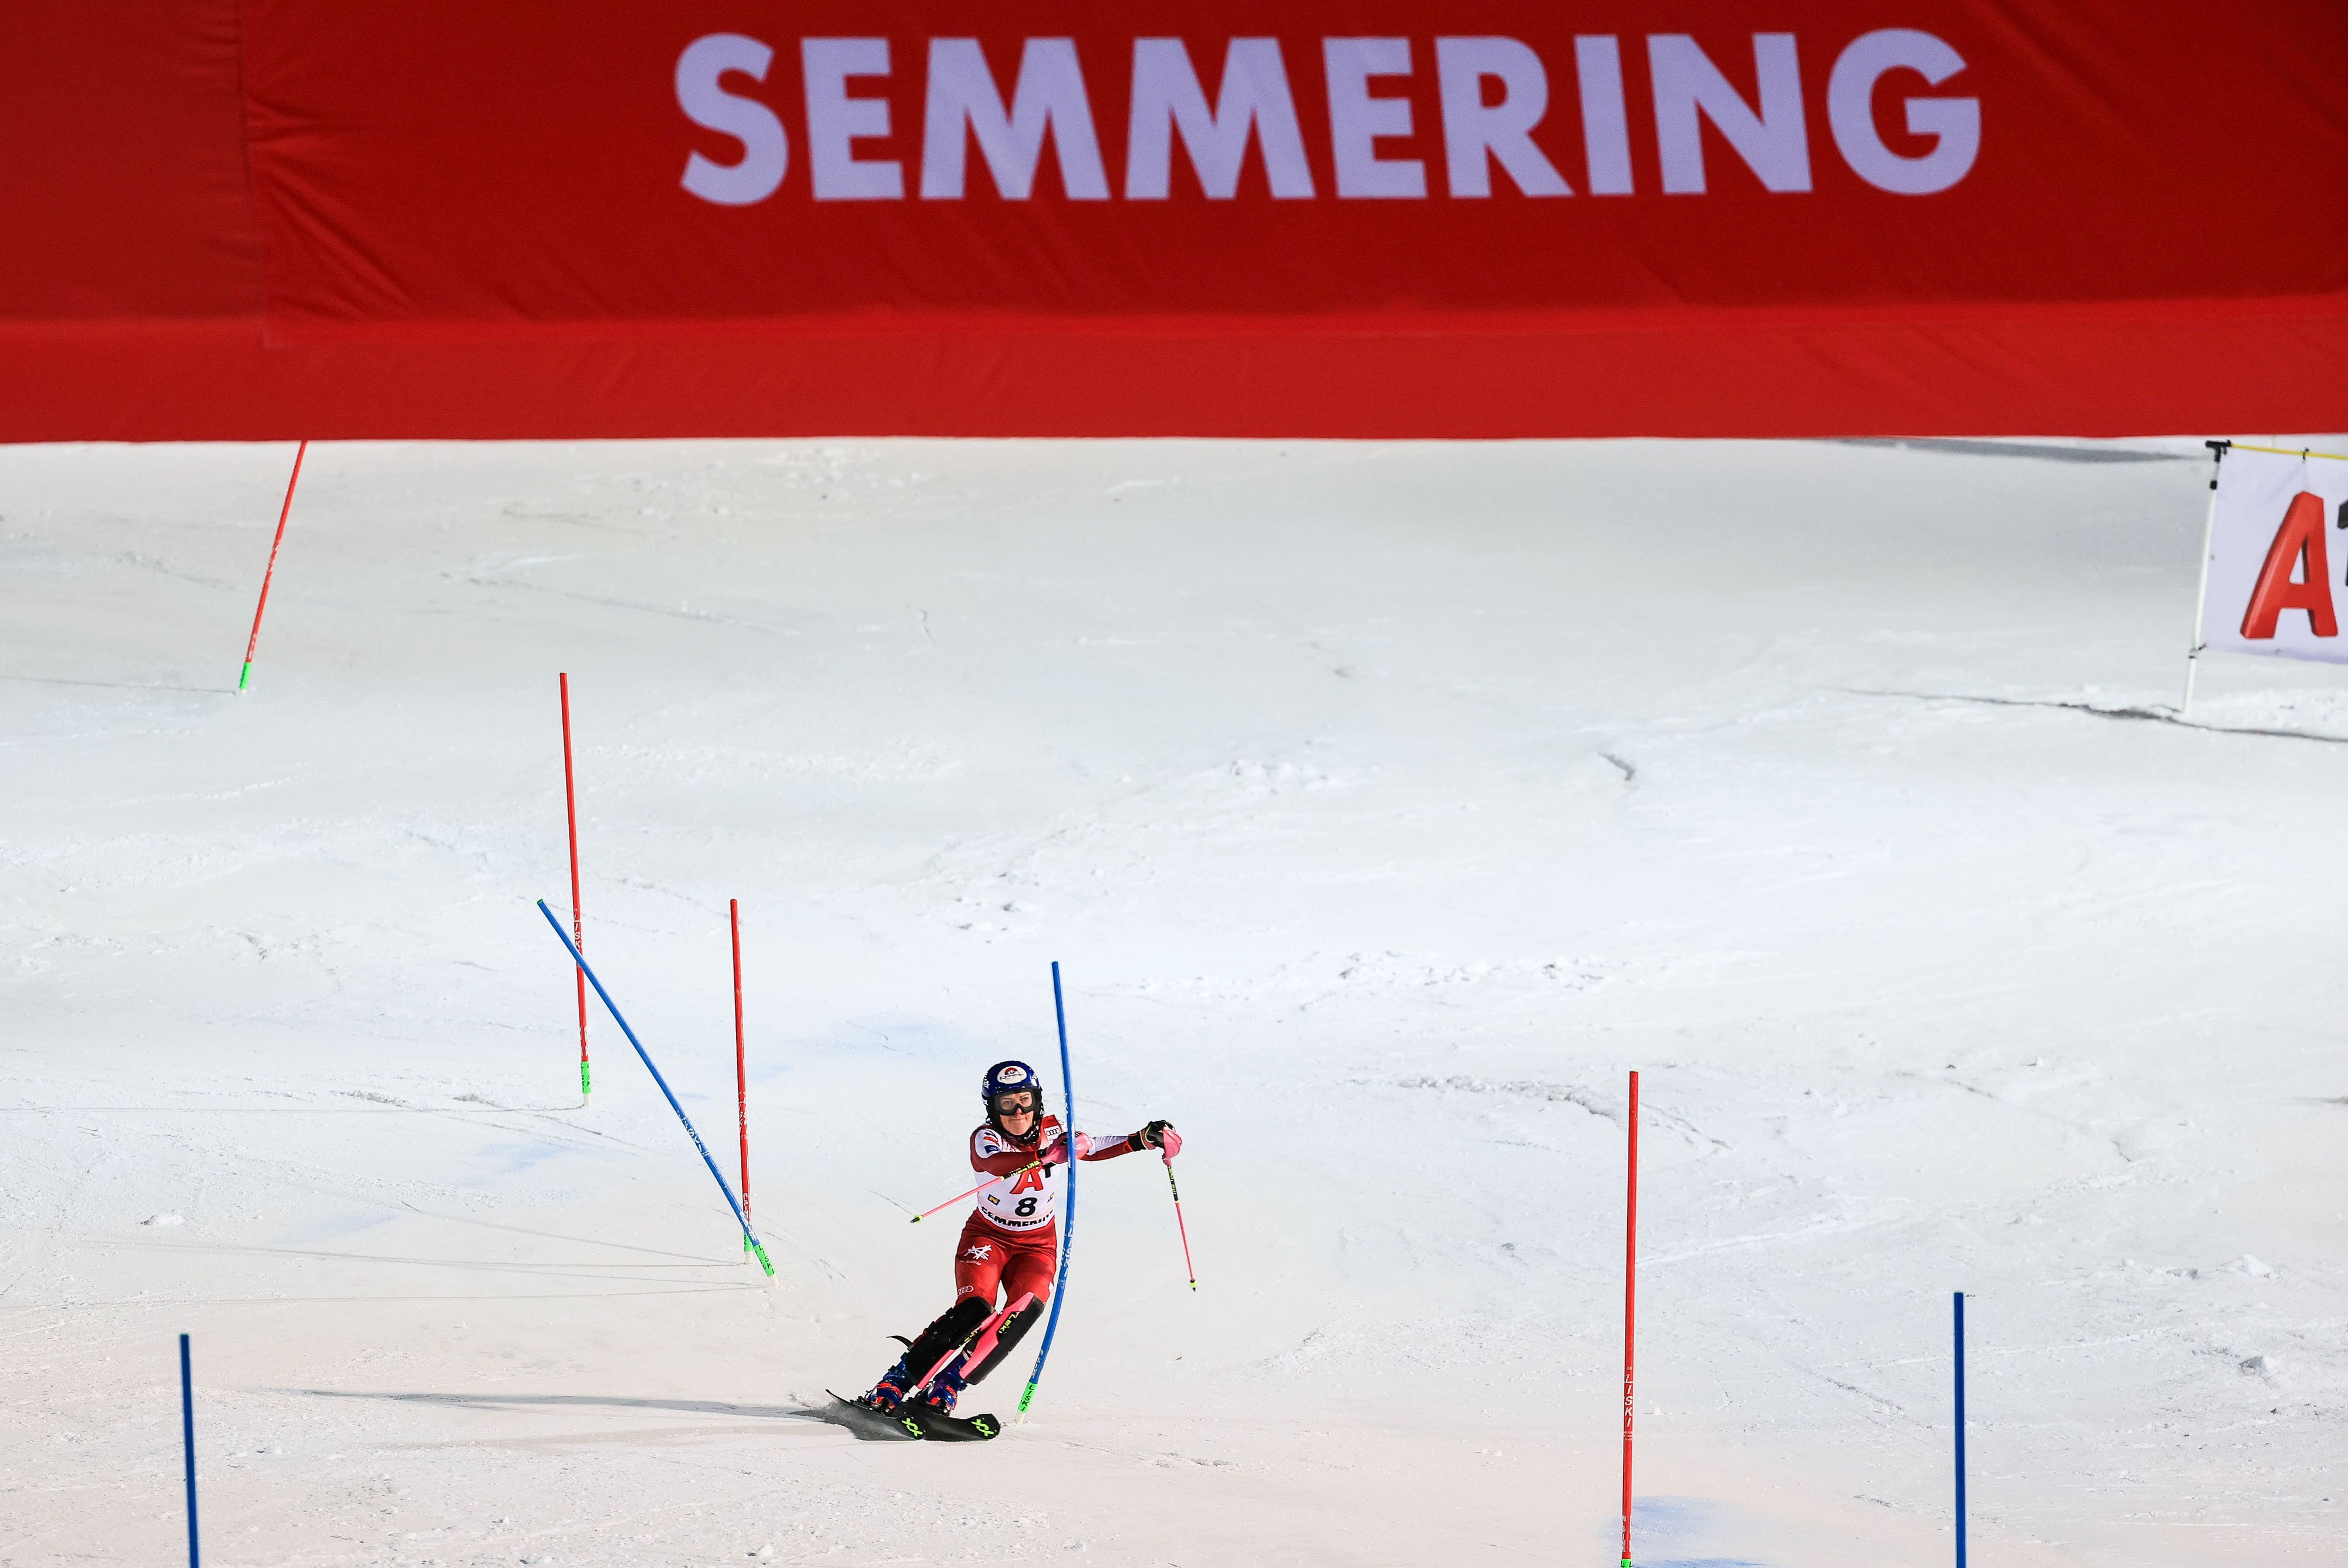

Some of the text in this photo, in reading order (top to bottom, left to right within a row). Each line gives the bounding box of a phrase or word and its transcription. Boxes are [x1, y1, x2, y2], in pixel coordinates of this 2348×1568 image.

[674, 28, 1982, 206] SEMMERING
[2240, 491, 2348, 639] A
[1014, 1197, 1037, 1217] 8
[759, 1245, 775, 1274] LISKI
[1021, 1385, 1034, 1411] LISKI
[1625, 1374, 1633, 1427] LISKI
